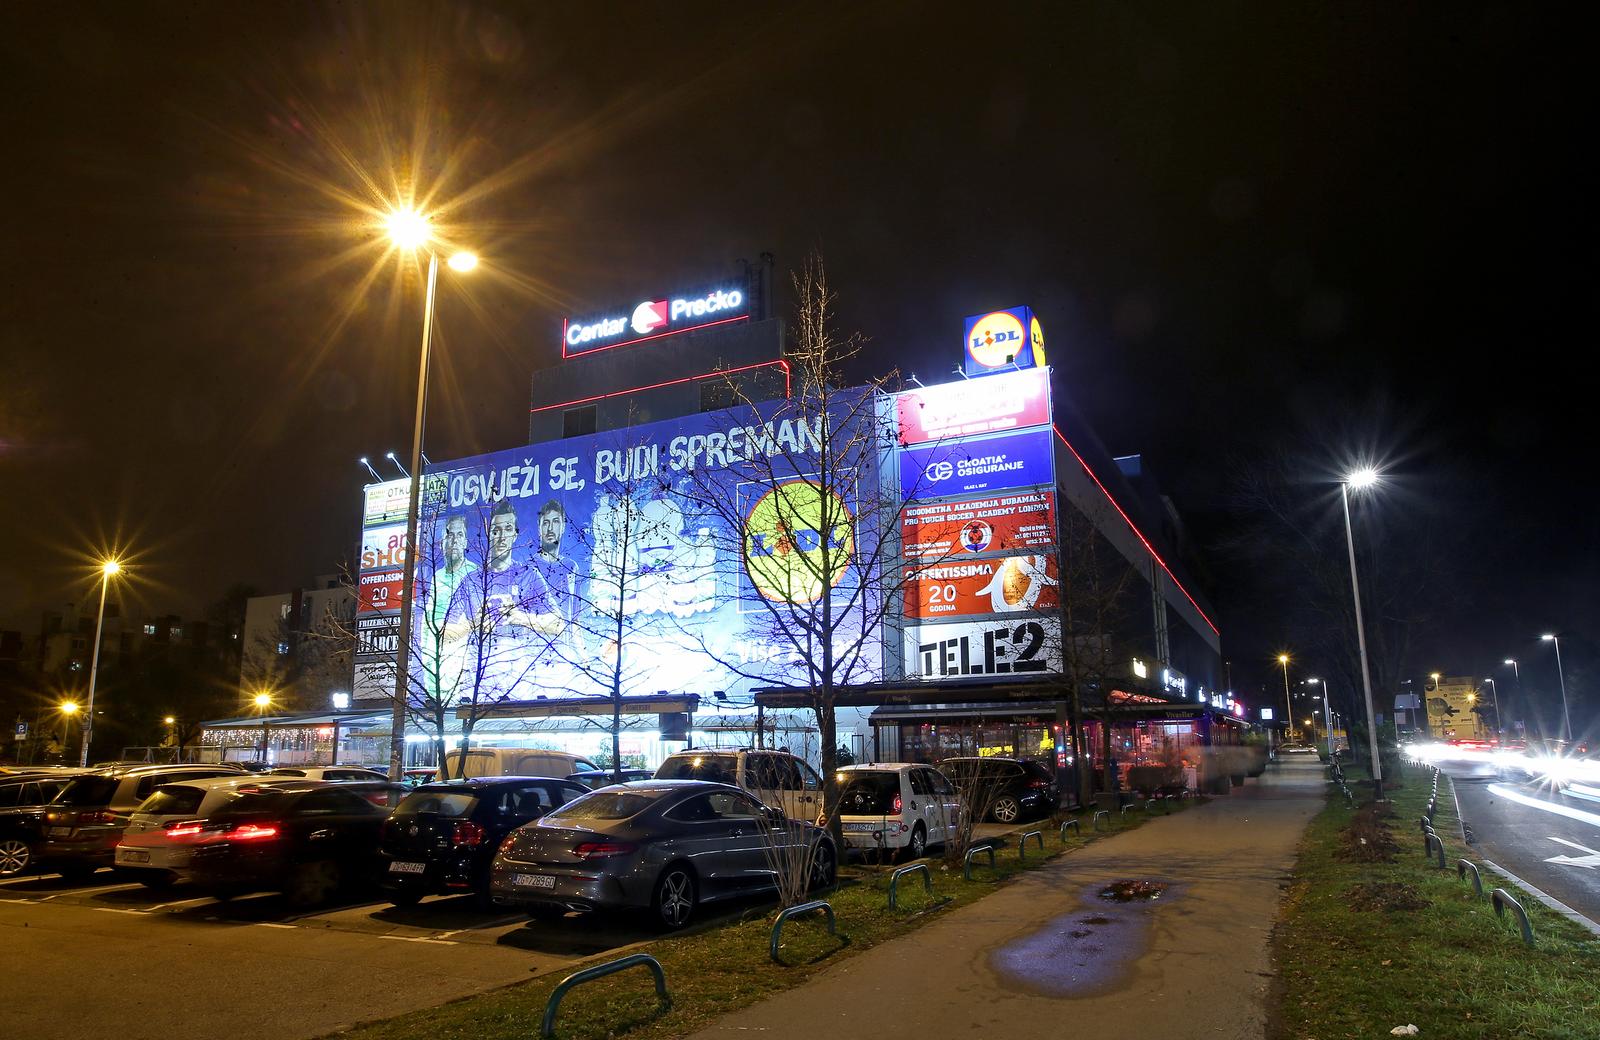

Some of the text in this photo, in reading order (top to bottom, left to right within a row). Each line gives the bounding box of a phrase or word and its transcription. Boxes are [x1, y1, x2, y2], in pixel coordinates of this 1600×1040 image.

[566, 290, 743, 345] Centar Prečko
[450, 458, 540, 508] OSVJEŽI
[549, 456, 586, 492] SE,
[595, 444, 658, 485] BUDI
[957, 461, 1024, 477] OSIGURANJE
[954, 502, 999, 511] AKADEMIJA
[905, 518, 919, 526] PRO
[947, 513, 975, 521] SOCCER
[977, 508, 1016, 518] ACADEMY
[361, 545, 421, 569] SHO
[372, 587, 388, 601] 20
[928, 585, 957, 604] 20
[929, 604, 957, 613] GODINA
[918, 621, 1047, 677] TELE2
